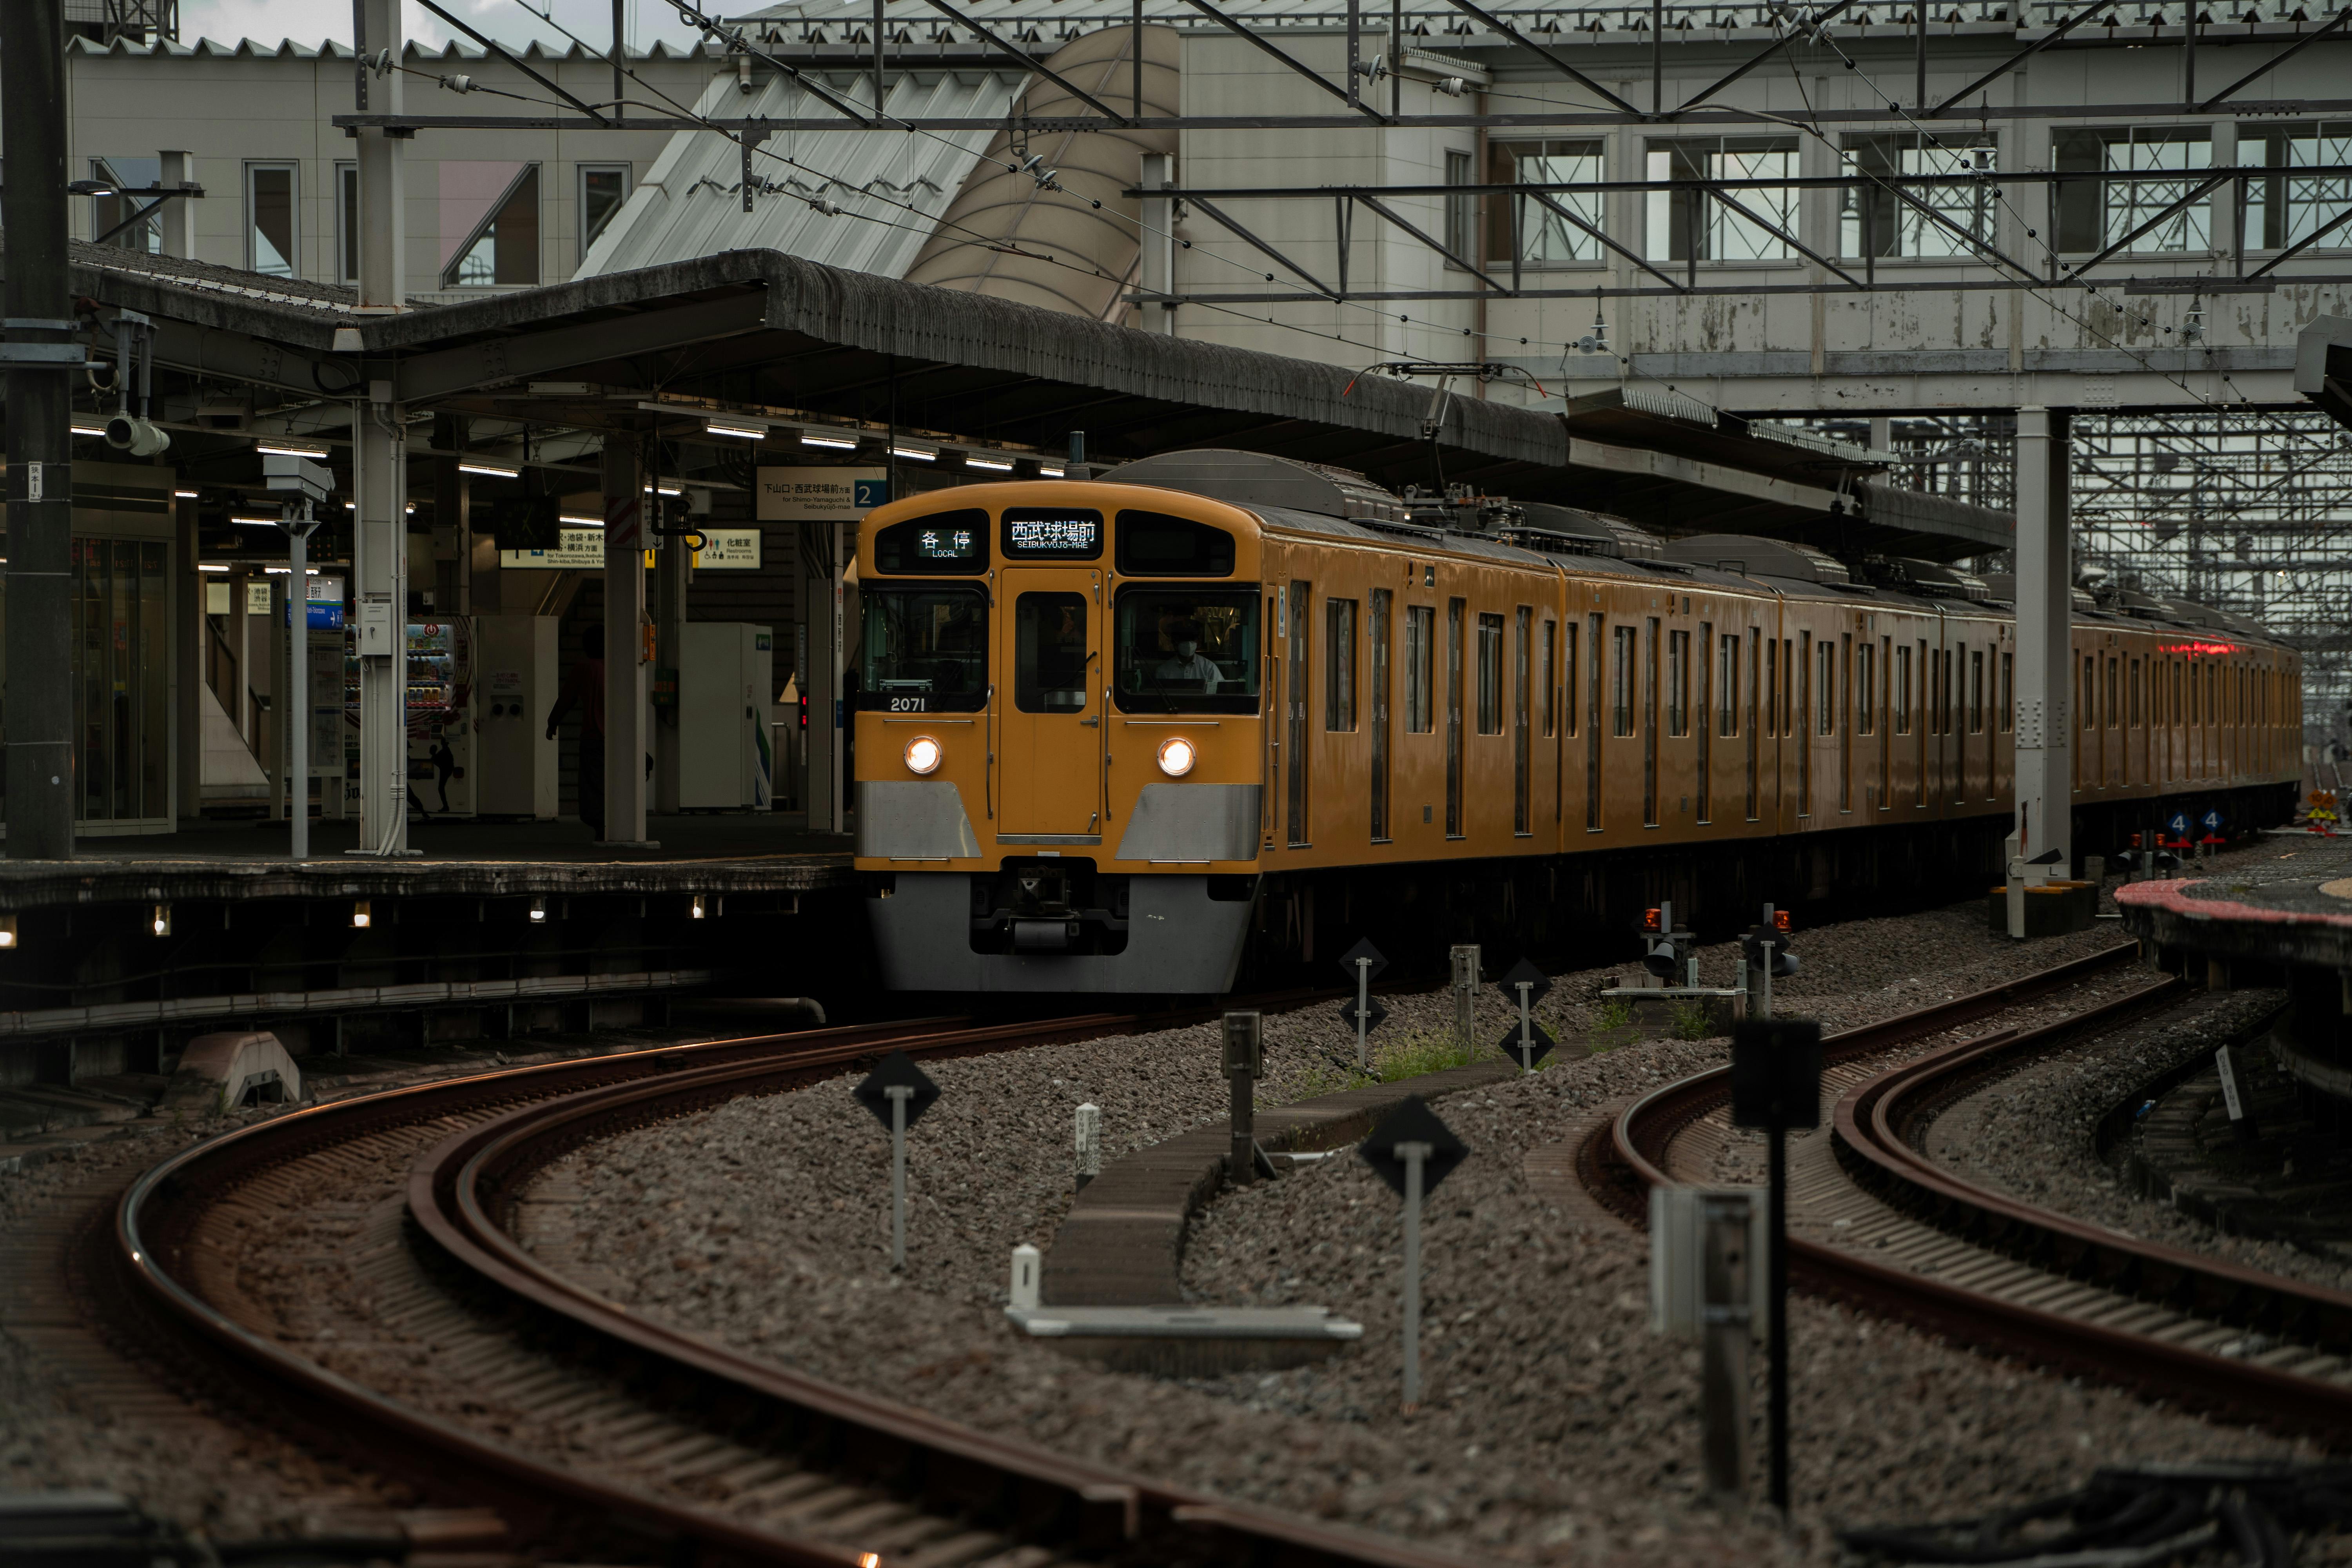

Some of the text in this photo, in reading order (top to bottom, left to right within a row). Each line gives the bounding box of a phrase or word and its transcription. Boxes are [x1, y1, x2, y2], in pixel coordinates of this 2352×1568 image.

[858, 486, 871, 504] 2
[1012, 521, 1095, 541] 西武球場前
[727, 538, 750, 547] 化粧室
[891, 698, 924, 711] 2071
[2172, 815, 2185, 831] 4
[2205, 812, 2218, 828] 4
